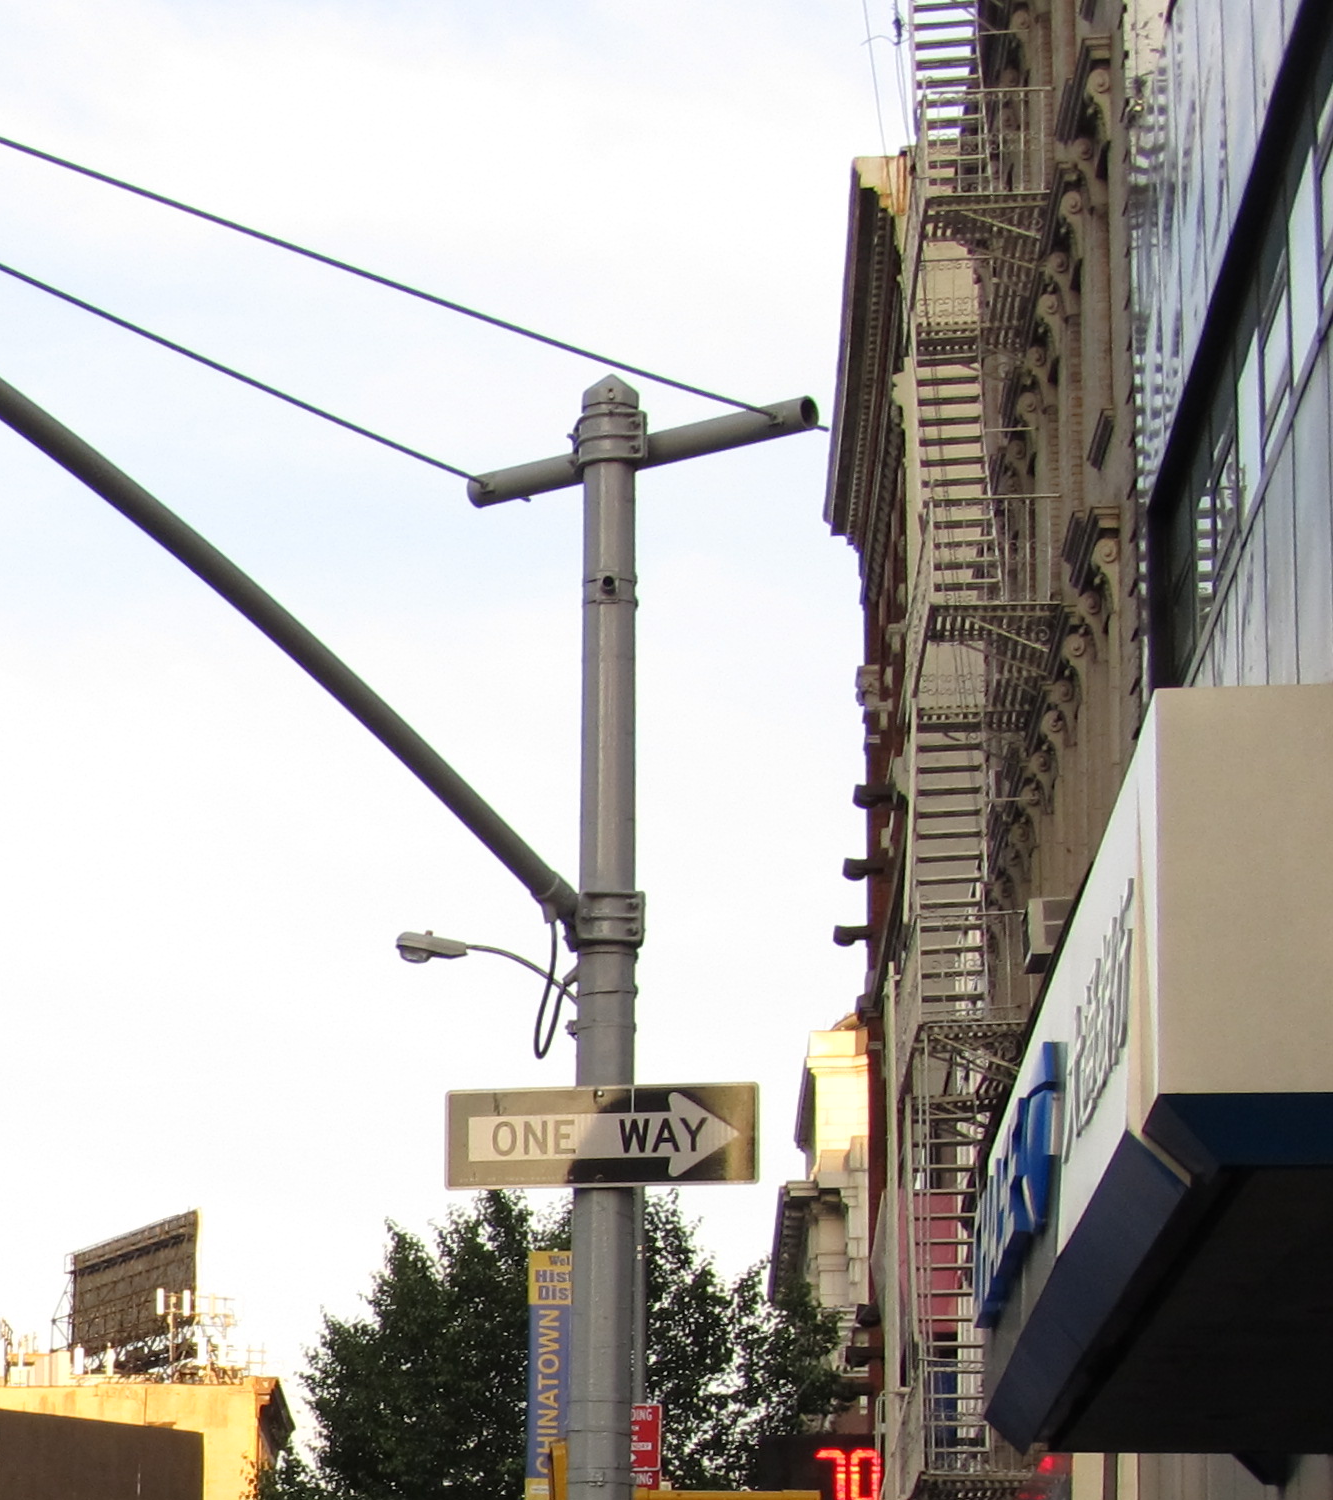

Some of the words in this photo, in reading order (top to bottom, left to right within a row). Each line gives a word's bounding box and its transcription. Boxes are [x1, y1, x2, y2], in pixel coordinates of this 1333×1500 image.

[491, 1118, 577, 1157] ONE
[619, 1116, 709, 1153] WAY
[536, 1308, 562, 1474] CHINATOWN
